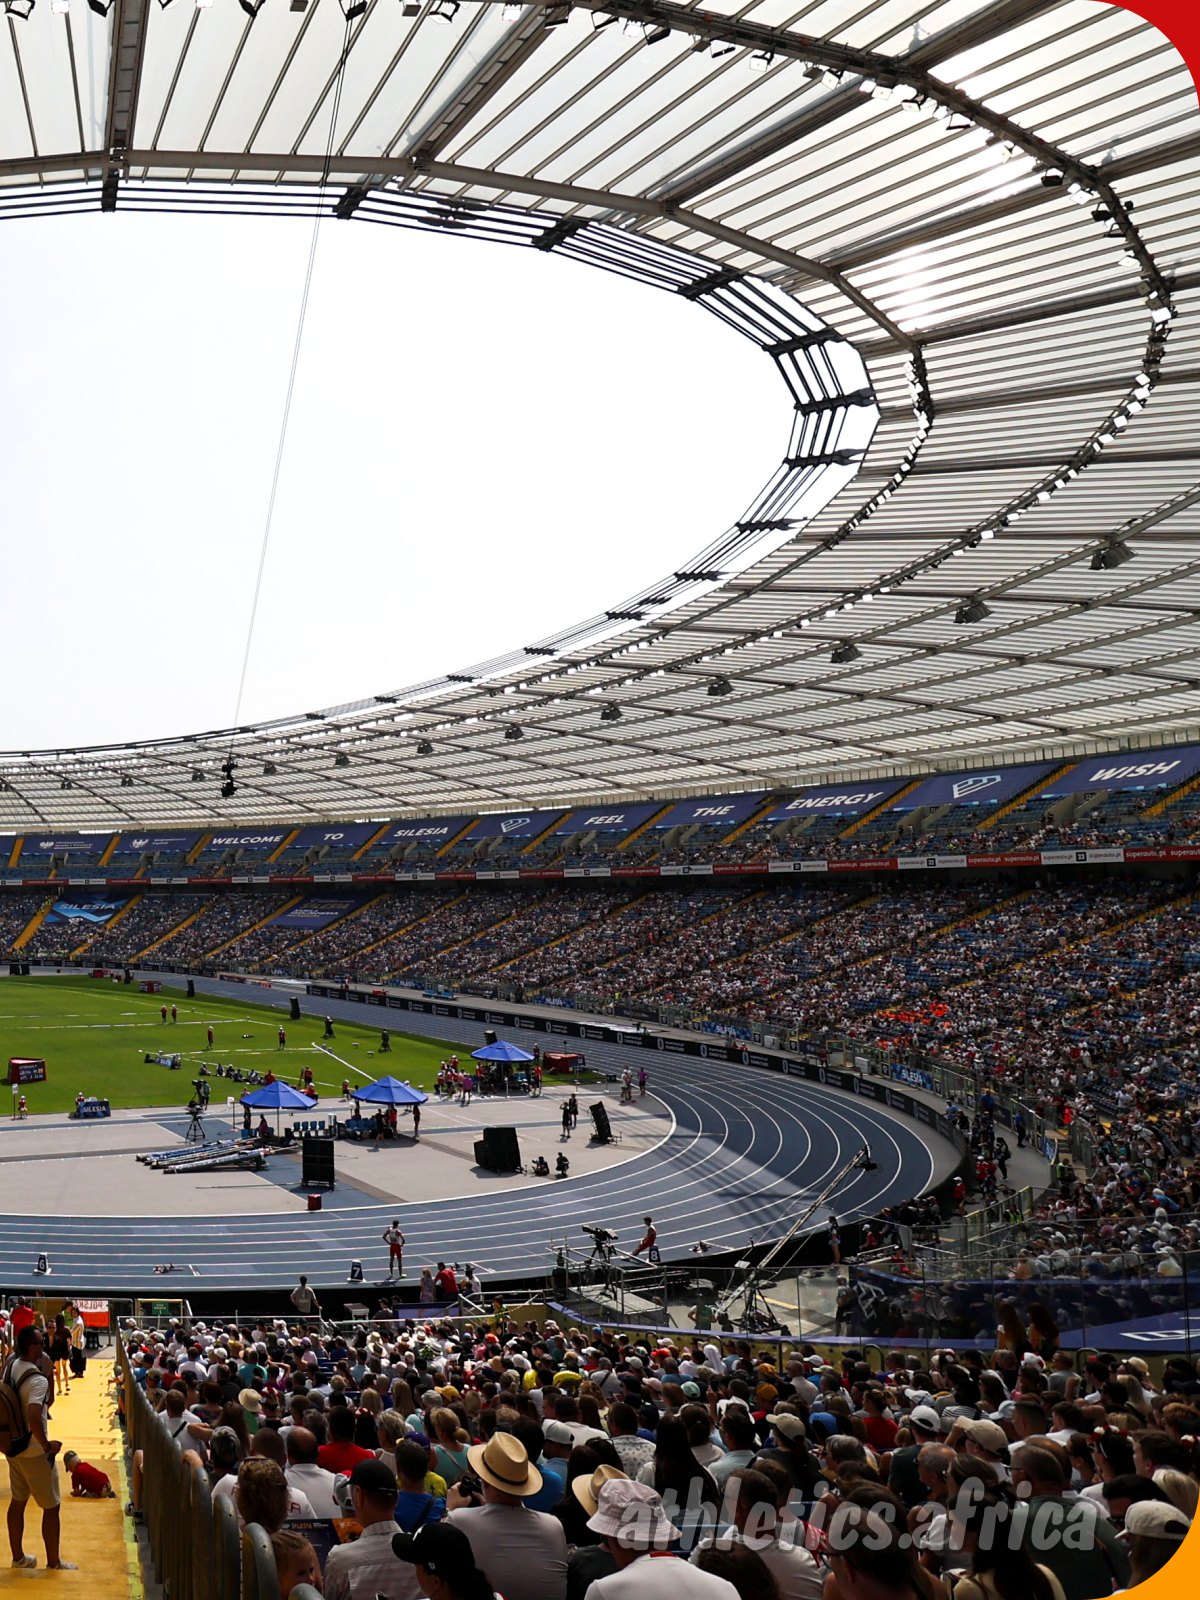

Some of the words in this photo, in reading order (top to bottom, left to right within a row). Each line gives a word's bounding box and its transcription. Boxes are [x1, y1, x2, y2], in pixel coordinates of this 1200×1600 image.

[1089, 760, 1182, 782] WISH
[785, 792, 884, 810] ENERGY
[692, 805, 735, 817] THE
[584, 815, 625, 825] FEEL
[323, 833, 344, 841] TO
[393, 827, 448, 837] SILESIA
[212, 835, 284, 845] WELCOME
[1004, 855, 1040, 863] superauto.pl
[1126, 850, 1167, 858] superauto.pl
[83, 1105, 107, 1113] SILESIA
[650, 1250, 658, 1260] 8
[39, 1259, 45, 1270] 6
[353, 1267, 360, 1277] 7
